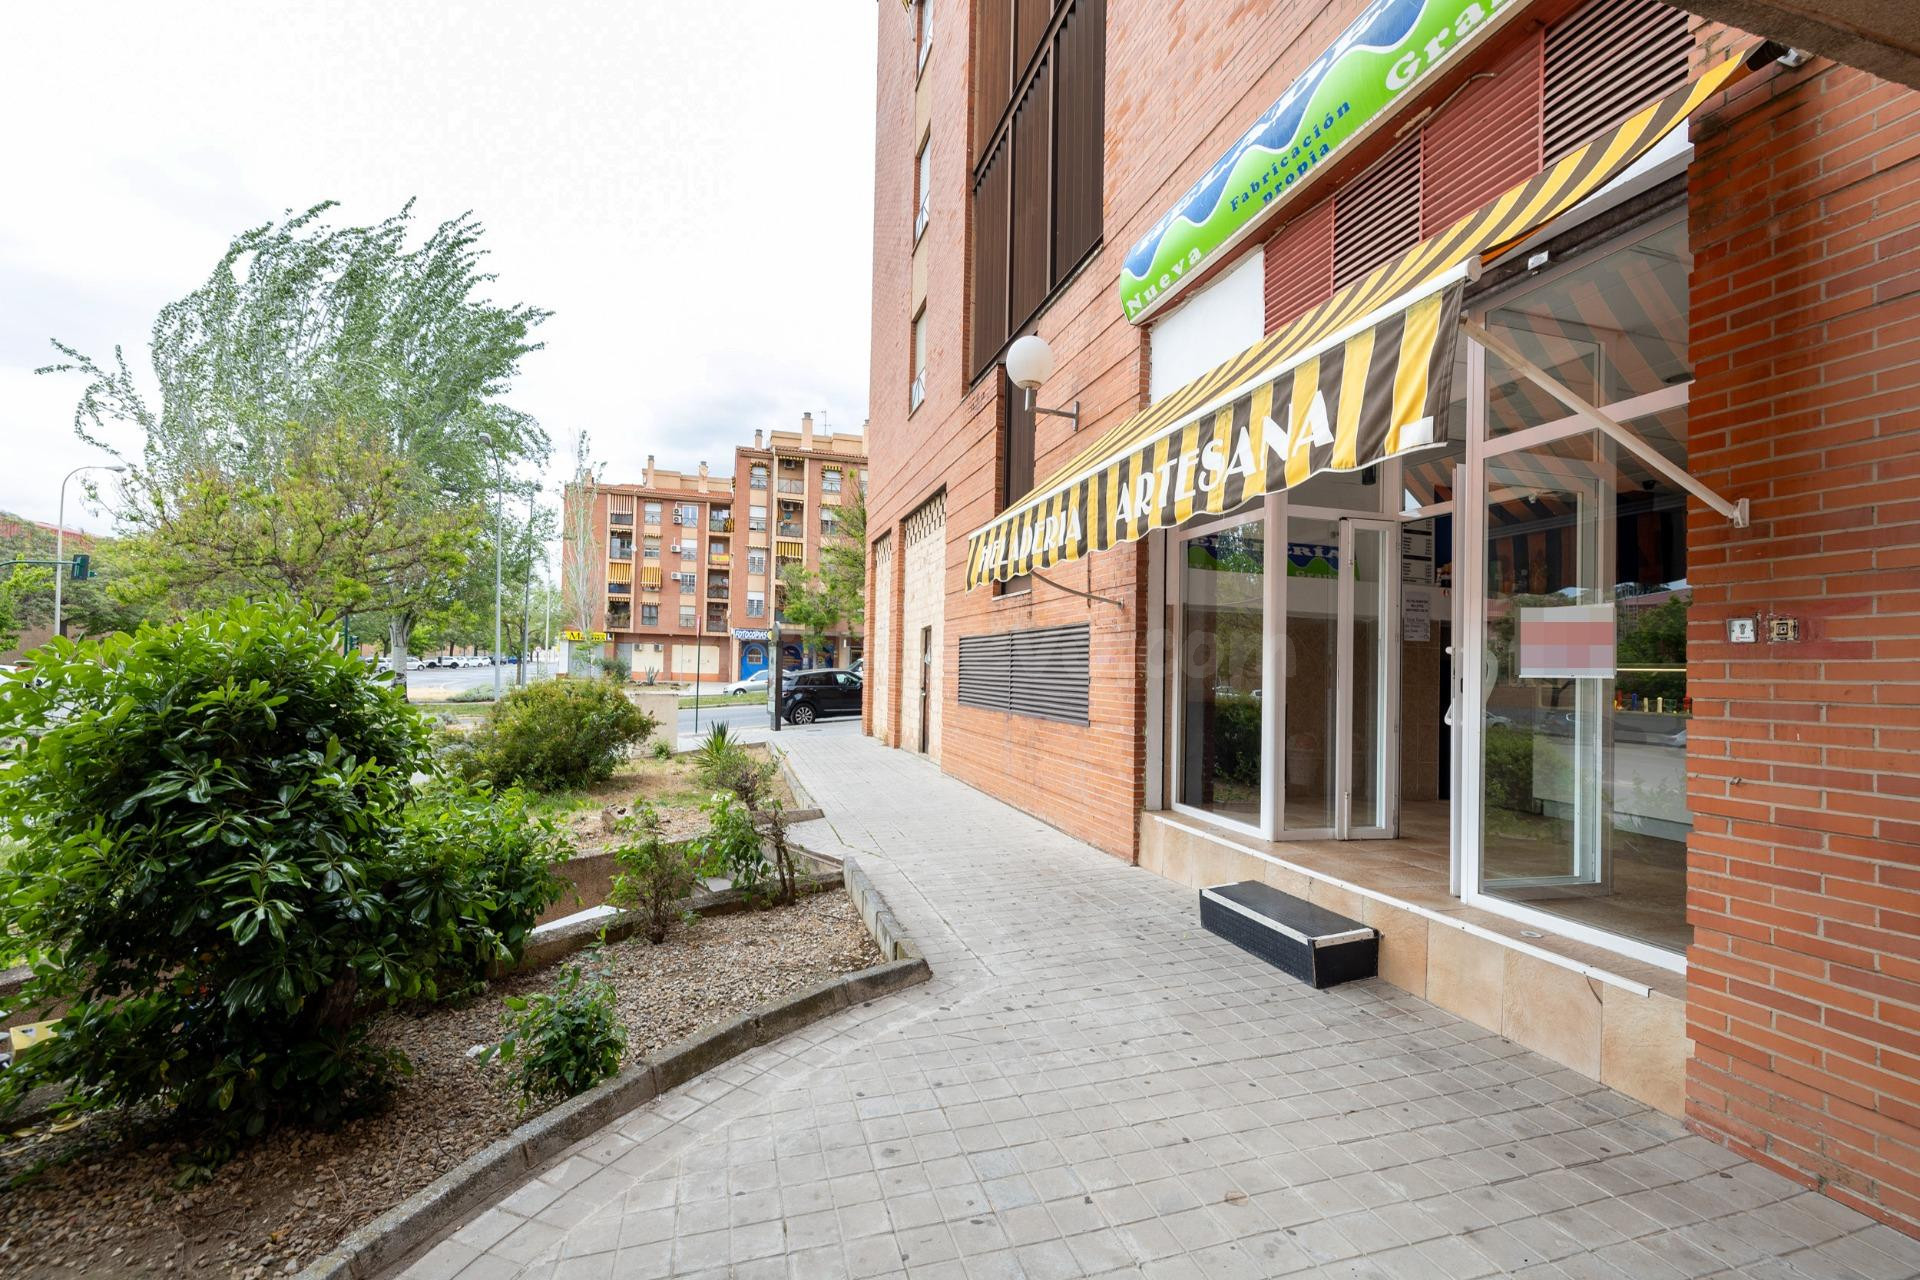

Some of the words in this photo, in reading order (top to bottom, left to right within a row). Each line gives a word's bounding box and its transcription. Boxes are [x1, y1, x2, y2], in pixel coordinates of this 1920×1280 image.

[1230, 102, 1351, 212] Fabricación
[1262, 143, 1330, 203] propia
[1126, 247, 1202, 316] Nueva
[978, 507, 1082, 573] HELADERIA
[1114, 389, 1335, 527] ARTESANA
[735, 630, 767, 639] FOTOCOPIAS
